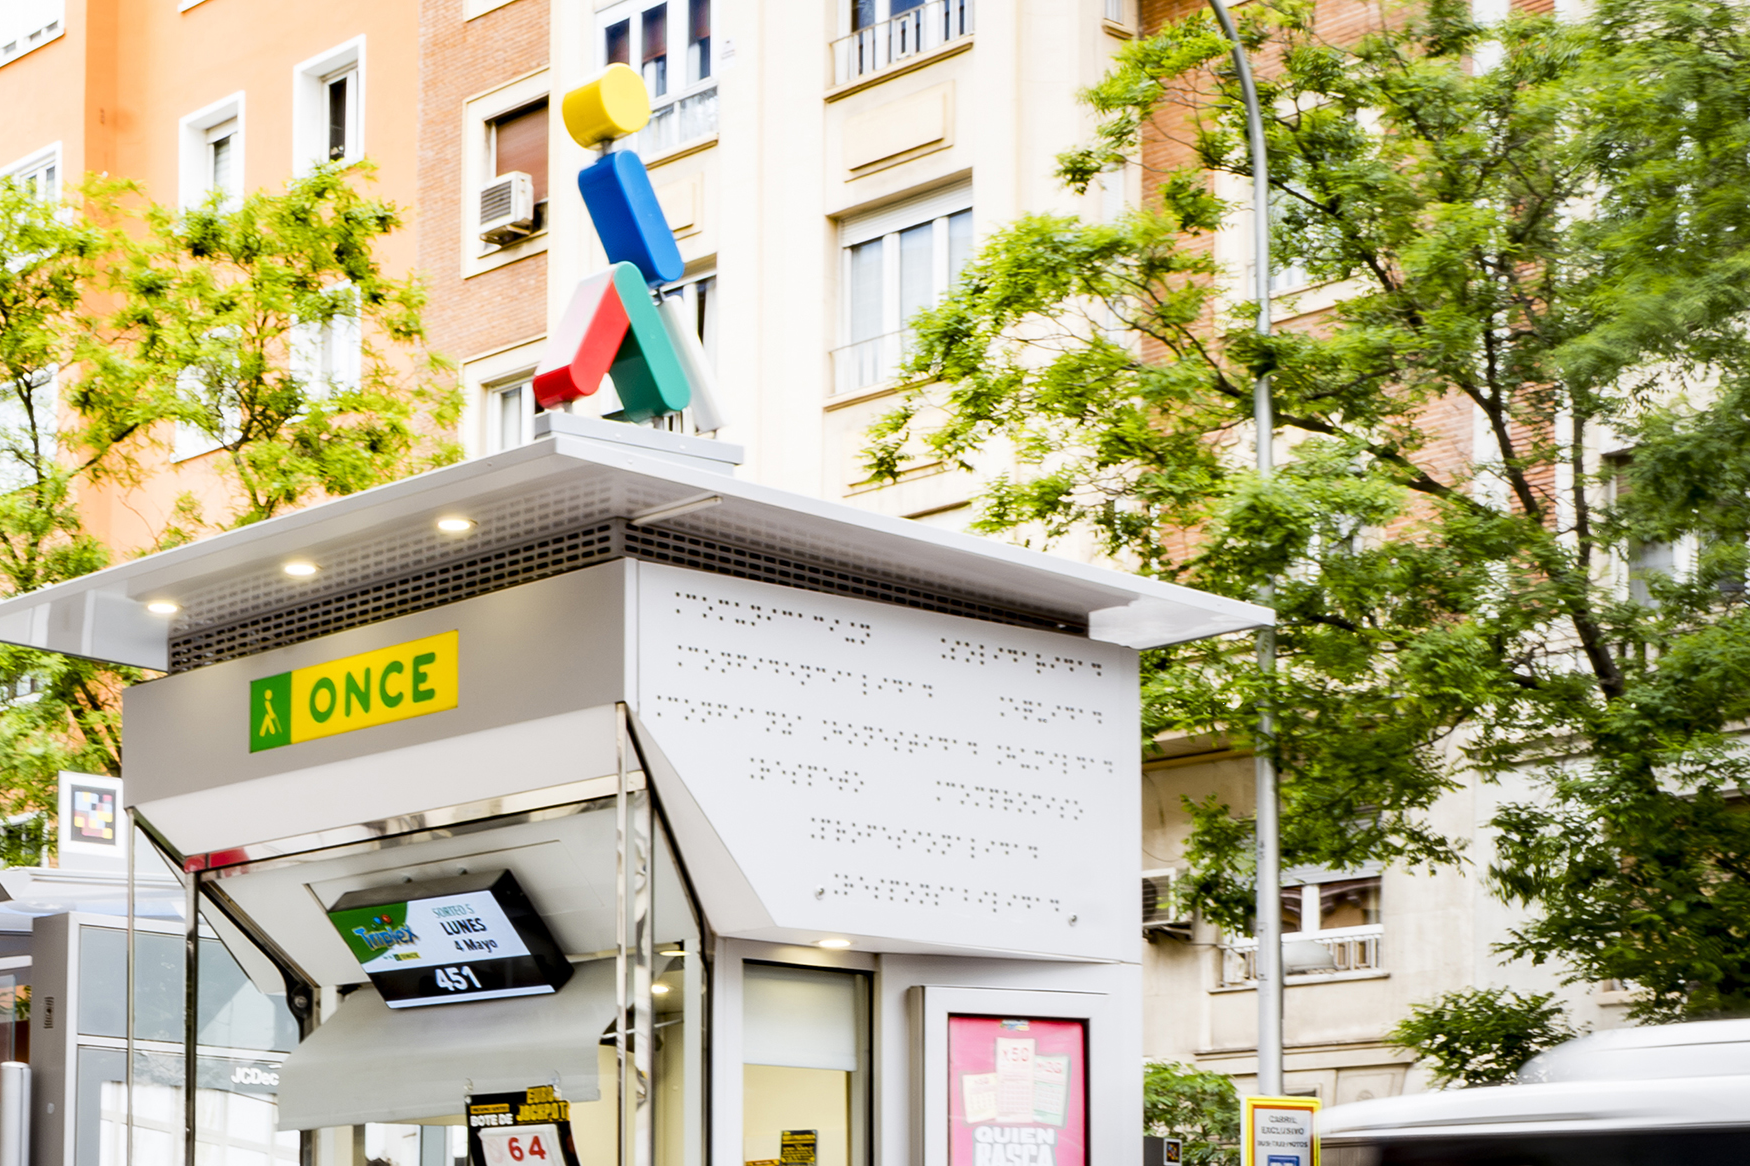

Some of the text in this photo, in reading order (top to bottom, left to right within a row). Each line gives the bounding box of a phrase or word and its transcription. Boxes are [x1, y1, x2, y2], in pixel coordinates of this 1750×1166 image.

[309, 652, 436, 724] ONCE
[440, 918, 487, 936] LUNES
[455, 939, 498, 953] 4 Mayo
[435, 966, 482, 992] 451
[470, 1113, 513, 1127] BOTE DE
[975, 1126, 1055, 1144] QUIEN
